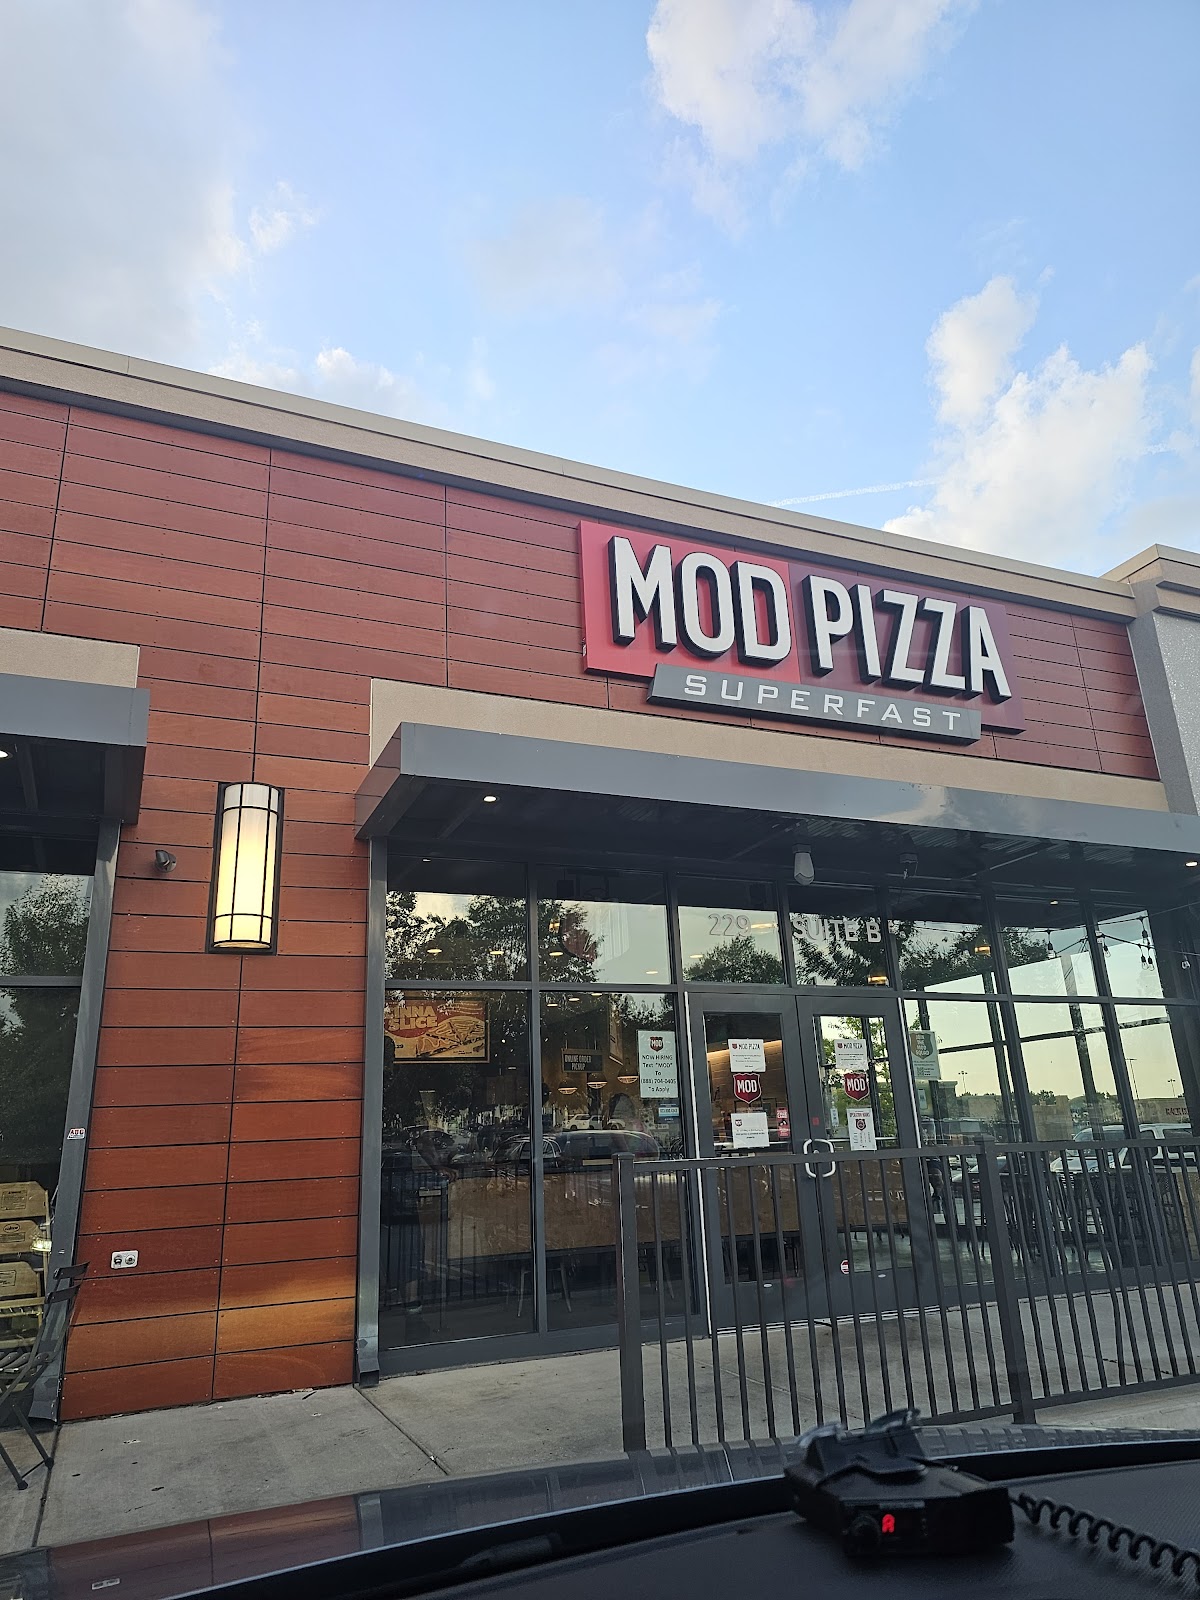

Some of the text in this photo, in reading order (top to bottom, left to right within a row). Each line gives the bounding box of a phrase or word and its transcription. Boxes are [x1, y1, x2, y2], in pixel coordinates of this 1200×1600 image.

[608, 536, 1013, 704] MOD PIZZA
[684, 674, 962, 731] SUPERFAST
[708, 913, 751, 937] 229
[792, 914, 882, 943] SUITE B
[387, 1005, 436, 1018] INNA
[388, 1016, 438, 1031] SLICE
[651, 1039, 663, 1047] MOD
[736, 1079, 758, 1093] MOD
[846, 1078, 866, 1092] MOD
